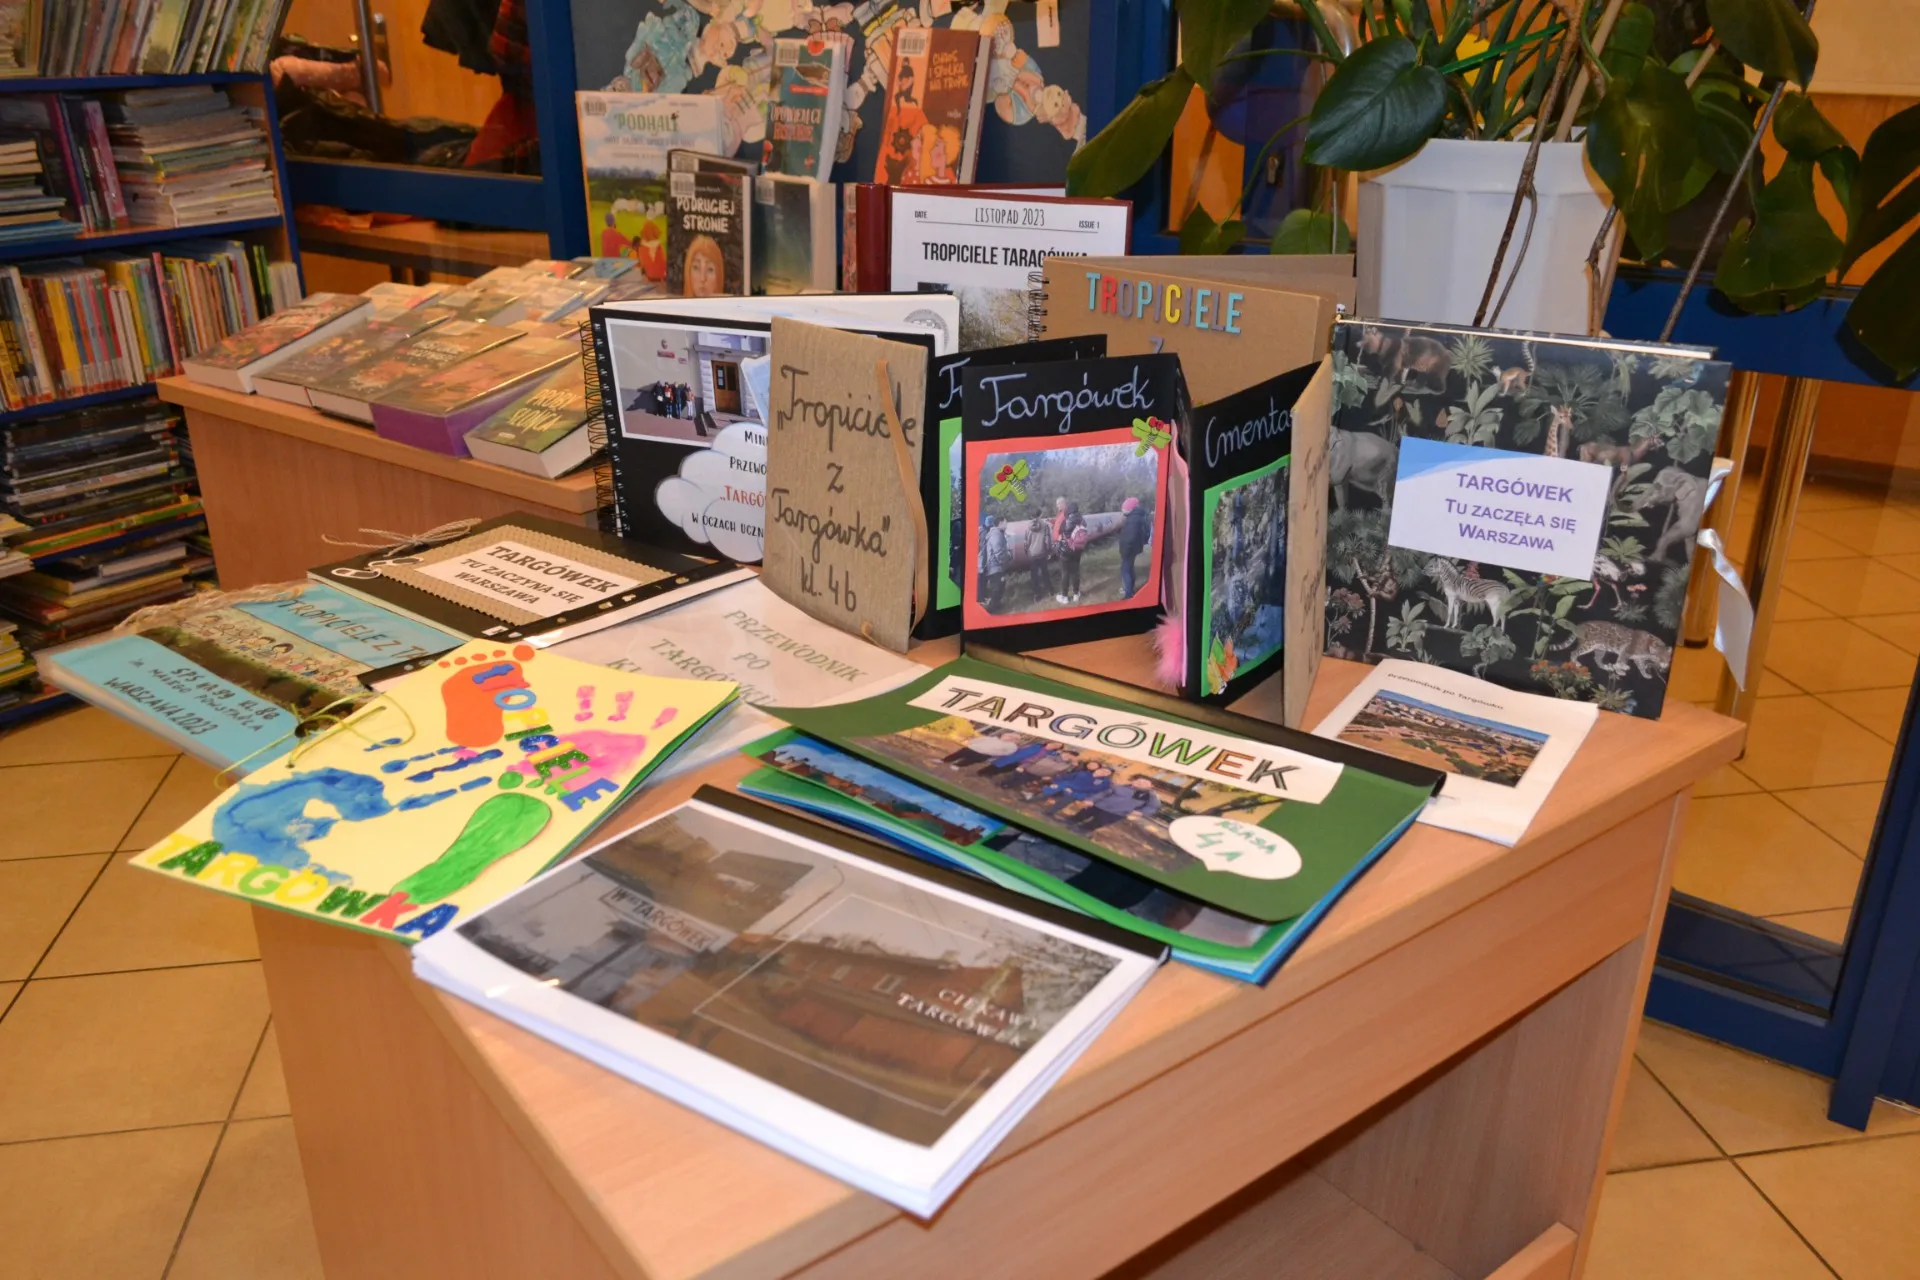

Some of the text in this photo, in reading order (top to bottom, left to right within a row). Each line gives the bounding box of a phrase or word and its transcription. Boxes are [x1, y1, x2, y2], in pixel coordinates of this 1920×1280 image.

[683, 214, 729, 233] STRONIE
[914, 210, 928, 219] DATE
[975, 207, 1019, 225] LISTOPAD
[1022, 208, 1045, 226] 2023
[1078, 220, 1095, 229] ISSUE
[922, 242, 998, 265] TROPICIELE
[1086, 272, 1244, 334] TROPICIELE
[979, 365, 1155, 433] Targówek
[1205, 396, 1294, 468] Cmenta
[719, 485, 767, 508] „TARGÓ
[1456, 472, 1574, 503] TARGÓWEK
[692, 512, 764, 538] W OCZACH UCZN
[1459, 523, 1554, 551] WARSZAWA
[1550, 516, 1577, 534] SIĘ
[460, 558, 584, 604] TU ZACZYNA SIĘ
[487, 546, 621, 593] TARGÓWEK
[455, 572, 540, 604] WARSZAWA
[723, 609, 869, 682] PRZEWODNIK
[733, 652, 770, 670] PO
[650, 638, 778, 705] TARGÓKU
[104, 677, 220, 735] WARSZAWA 2023
[936, 686, 1304, 792] TARGÓWEK
